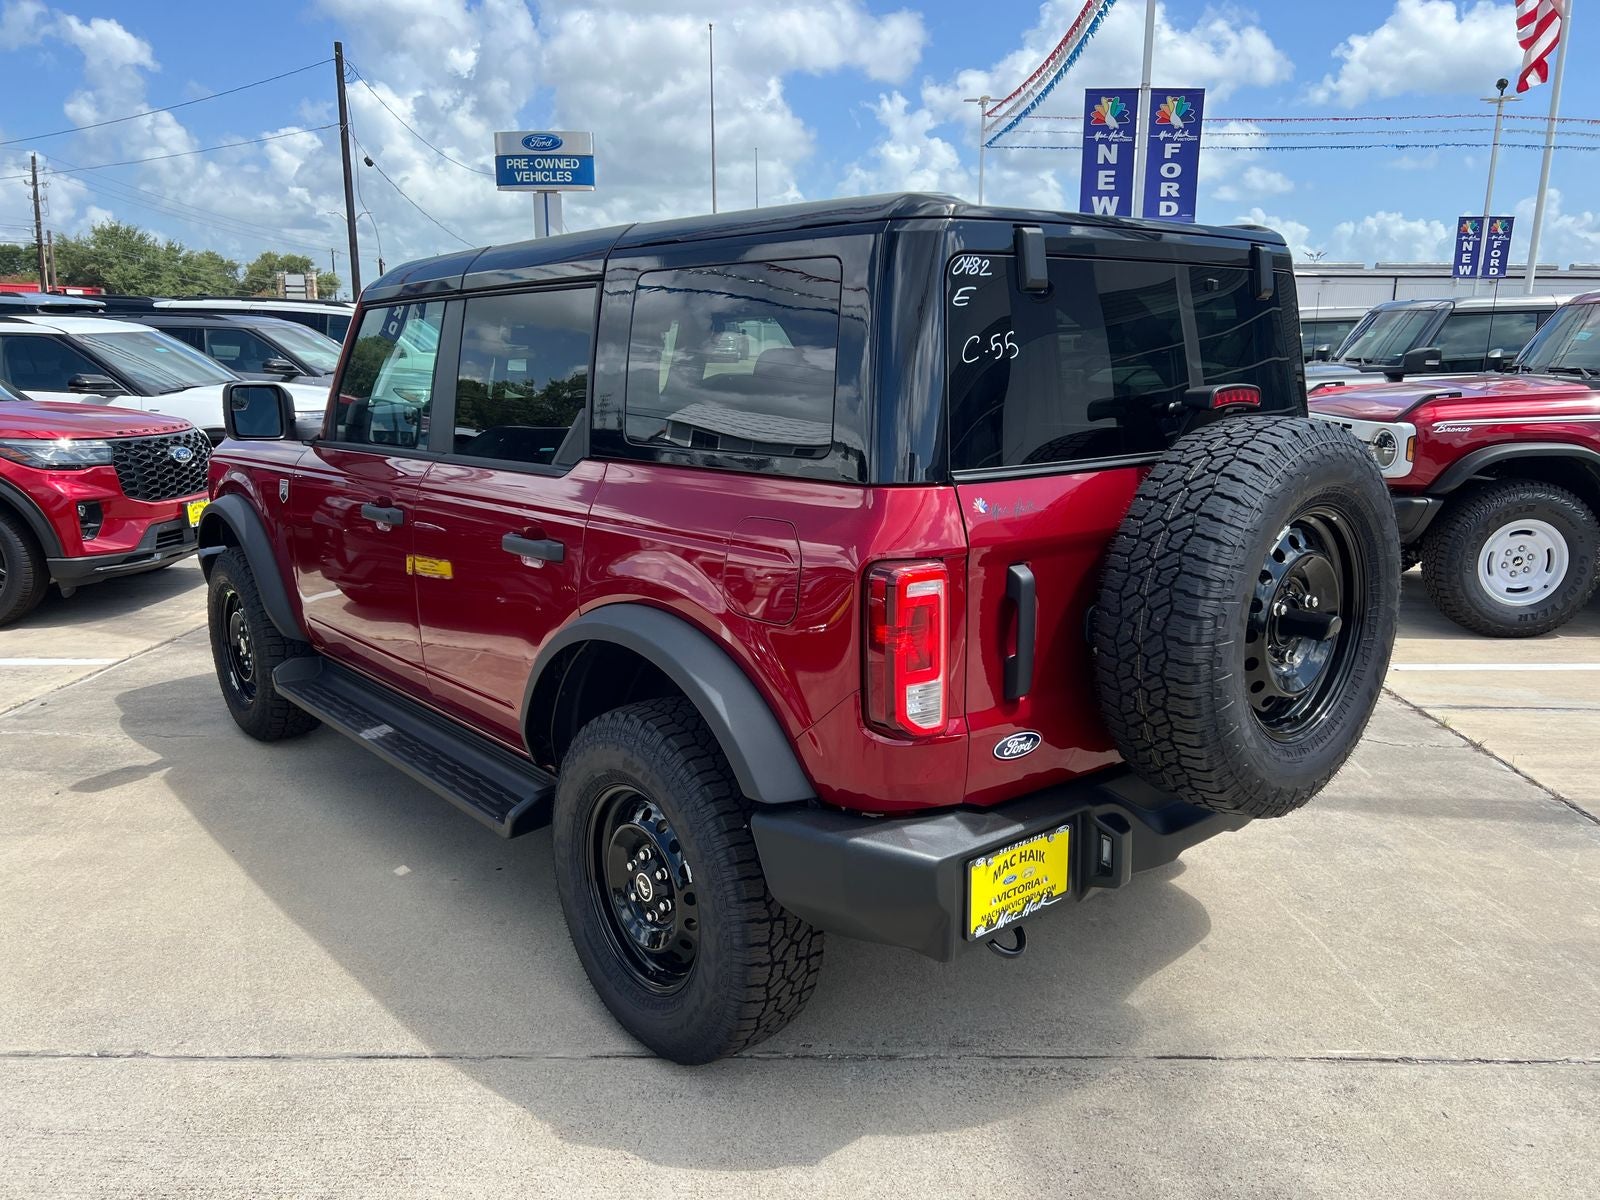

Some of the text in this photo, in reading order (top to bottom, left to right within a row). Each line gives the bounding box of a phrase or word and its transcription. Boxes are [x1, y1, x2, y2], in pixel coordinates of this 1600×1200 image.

[529, 137, 553, 148] Ford
[506, 158, 580, 169] PRE-OWNED
[514, 171, 573, 182] VEHICLES
[1091, 143, 1120, 217] NEW
[1158, 143, 1182, 217] FORD
[952, 256, 993, 276] 0482
[1458, 241, 1474, 275] NEW
[1488, 240, 1502, 275] FORD
[952, 286, 977, 306] E
[1433, 424, 1472, 433] Bronco
[1003, 736, 1034, 756] Ford
[992, 849, 1046, 883] MAC HAIK
[996, 877, 1041, 904] VICTORIA
[989, 909, 1022, 931] Mac
